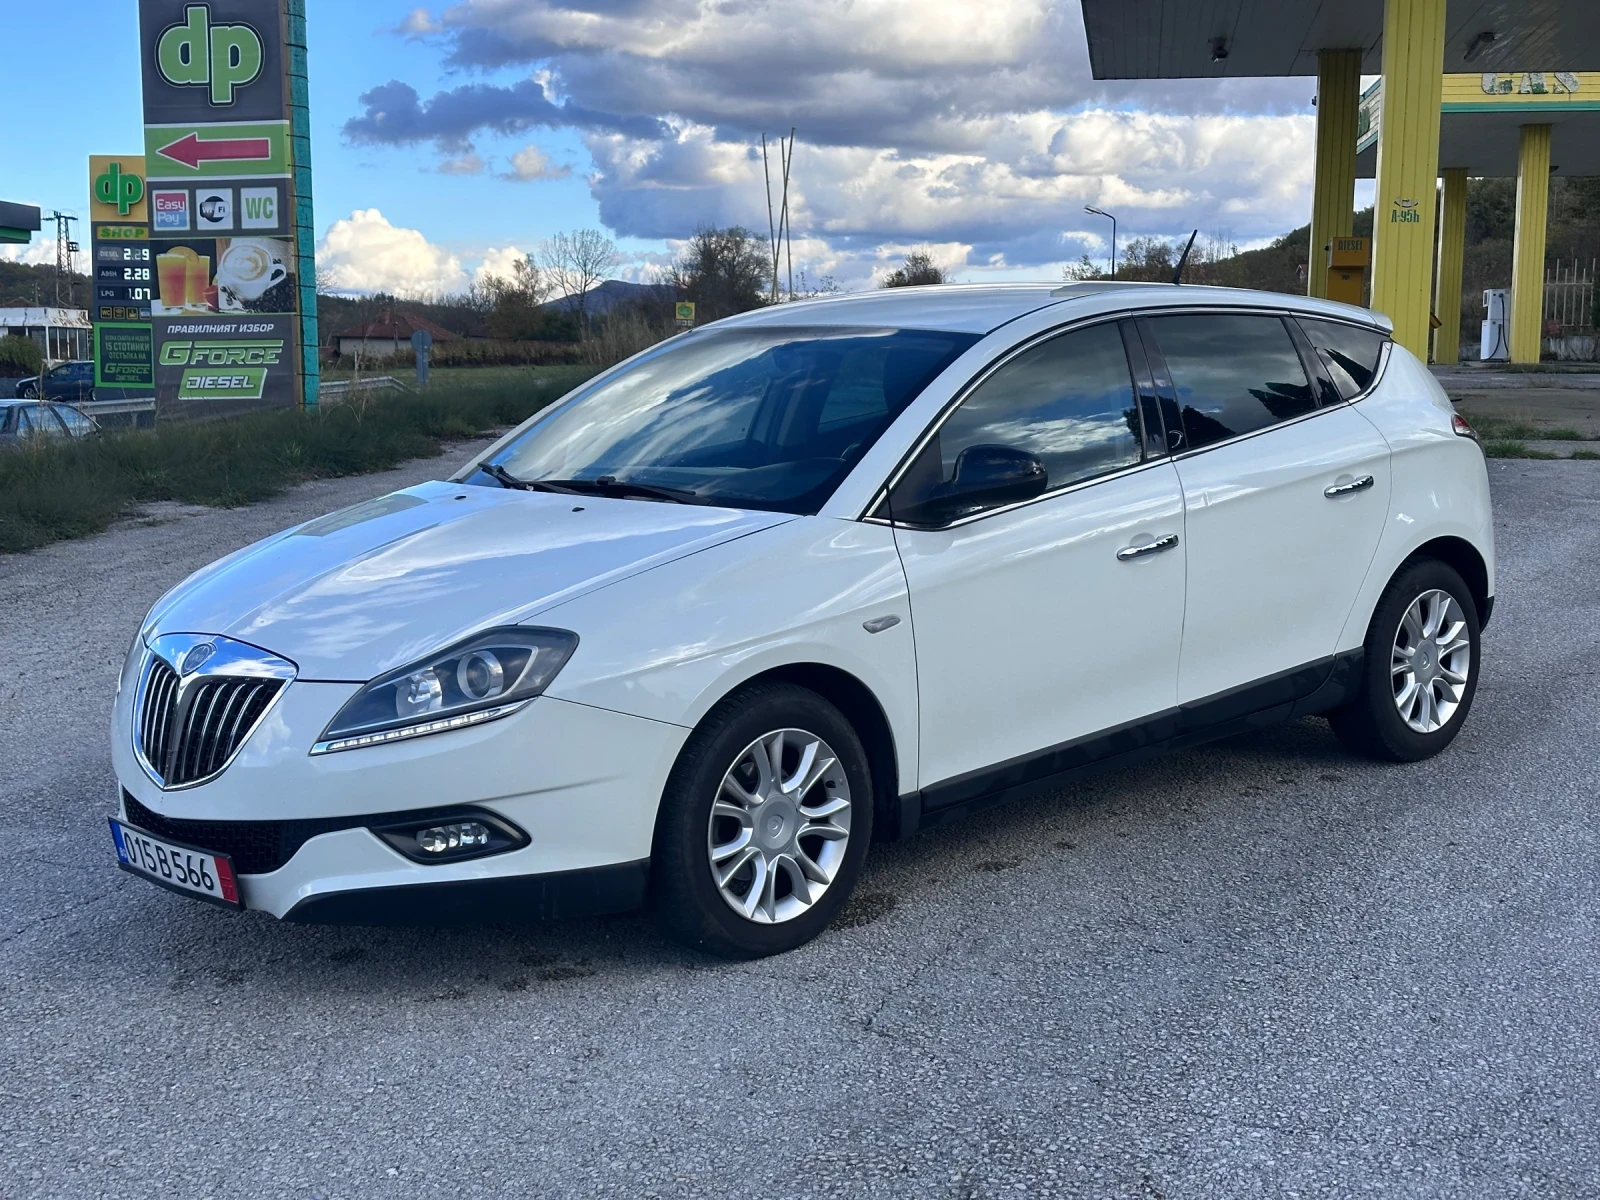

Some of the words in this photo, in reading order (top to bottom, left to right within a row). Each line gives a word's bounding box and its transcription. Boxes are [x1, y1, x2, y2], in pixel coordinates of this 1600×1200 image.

[158, 6, 262, 102] dp
[95, 162, 143, 215] dp
[156, 199, 185, 212] Easy
[245, 197, 274, 219] WC
[157, 212, 180, 225] Pay
[100, 228, 144, 238] SHOP
[1338, 240, 1363, 251] DIESEL
[123, 248, 150, 260] 2.29
[124, 268, 150, 280] 2.28
[128, 288, 151, 300] 1.07
[167, 324, 237, 333] ПРАВИЛНИЯТ
[239, 323, 274, 333] ИЗБОР
[105, 342, 112, 351] 15
[114, 342, 150, 351] СТОТИНКИ
[186, 376, 255, 389] DIESEL
[124, 832, 214, 890] 015B566
